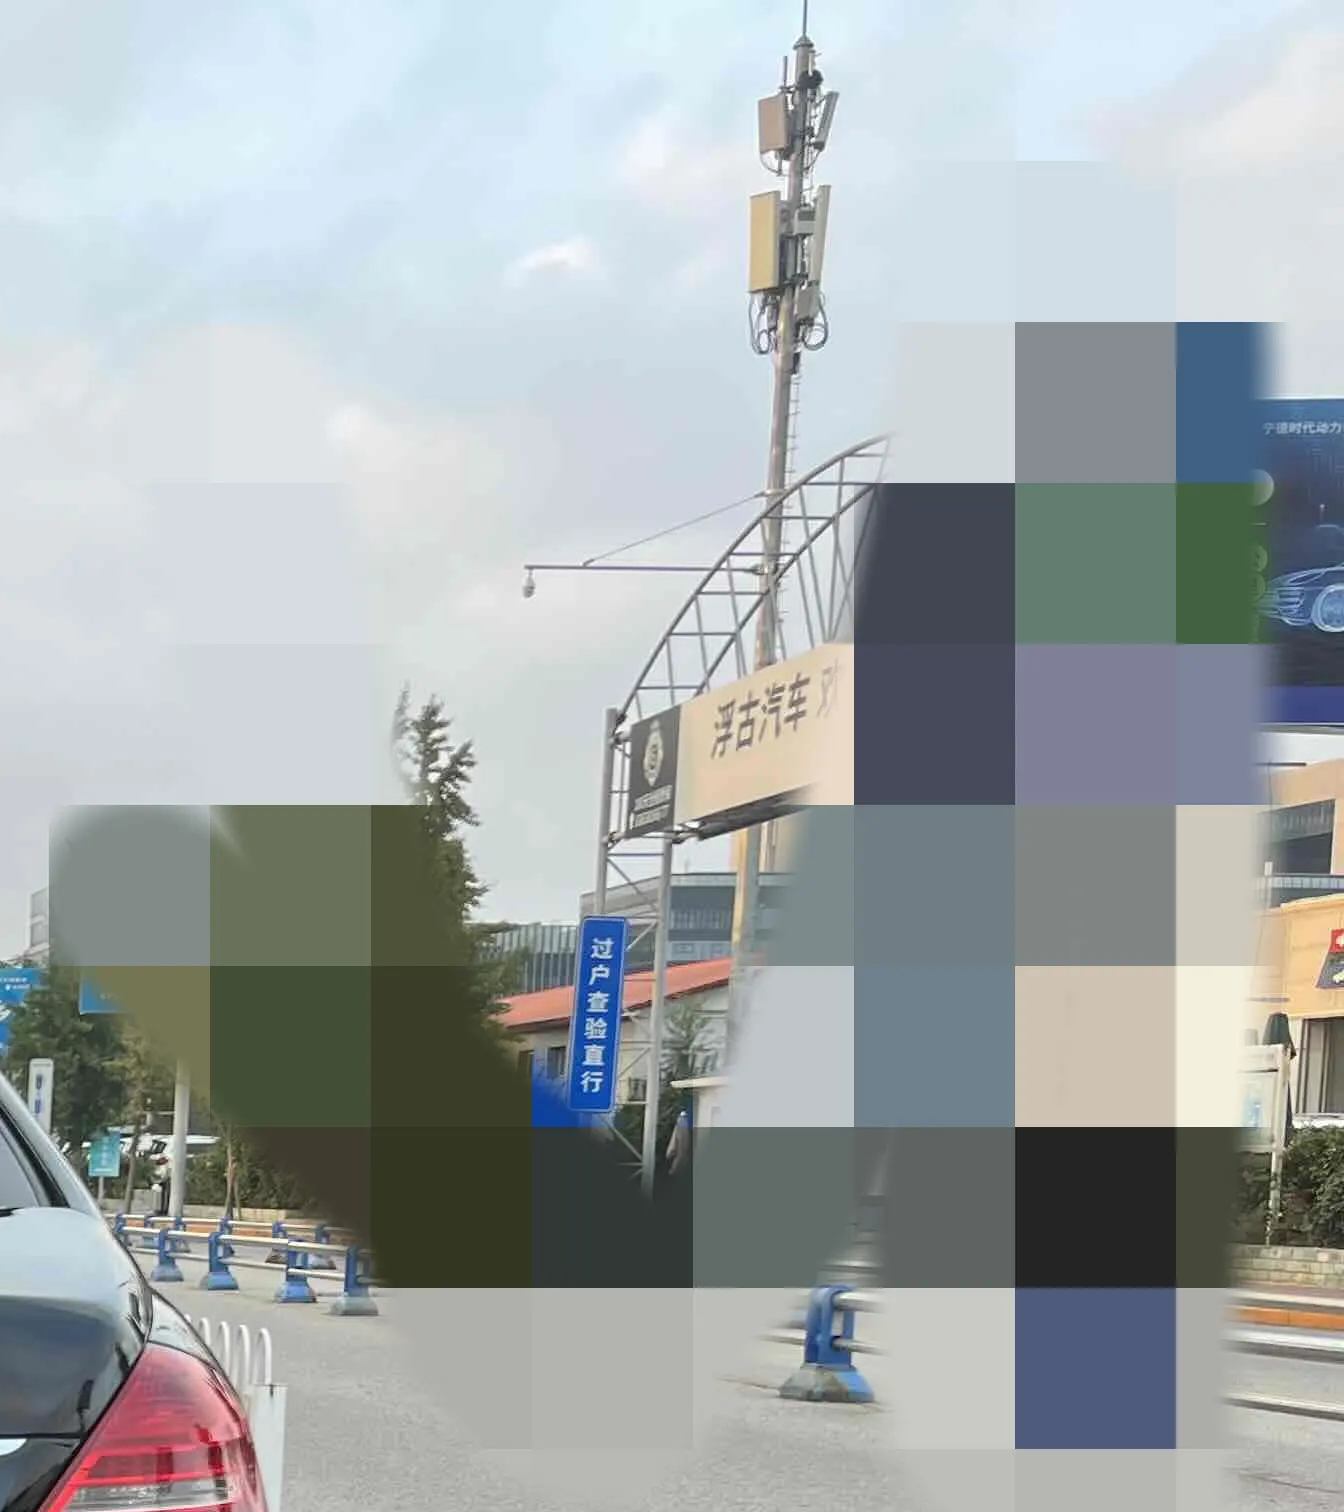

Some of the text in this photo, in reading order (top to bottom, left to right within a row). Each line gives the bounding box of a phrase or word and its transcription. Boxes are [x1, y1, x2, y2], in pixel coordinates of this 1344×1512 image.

[580, 937, 615, 1093] 过户查验直行
